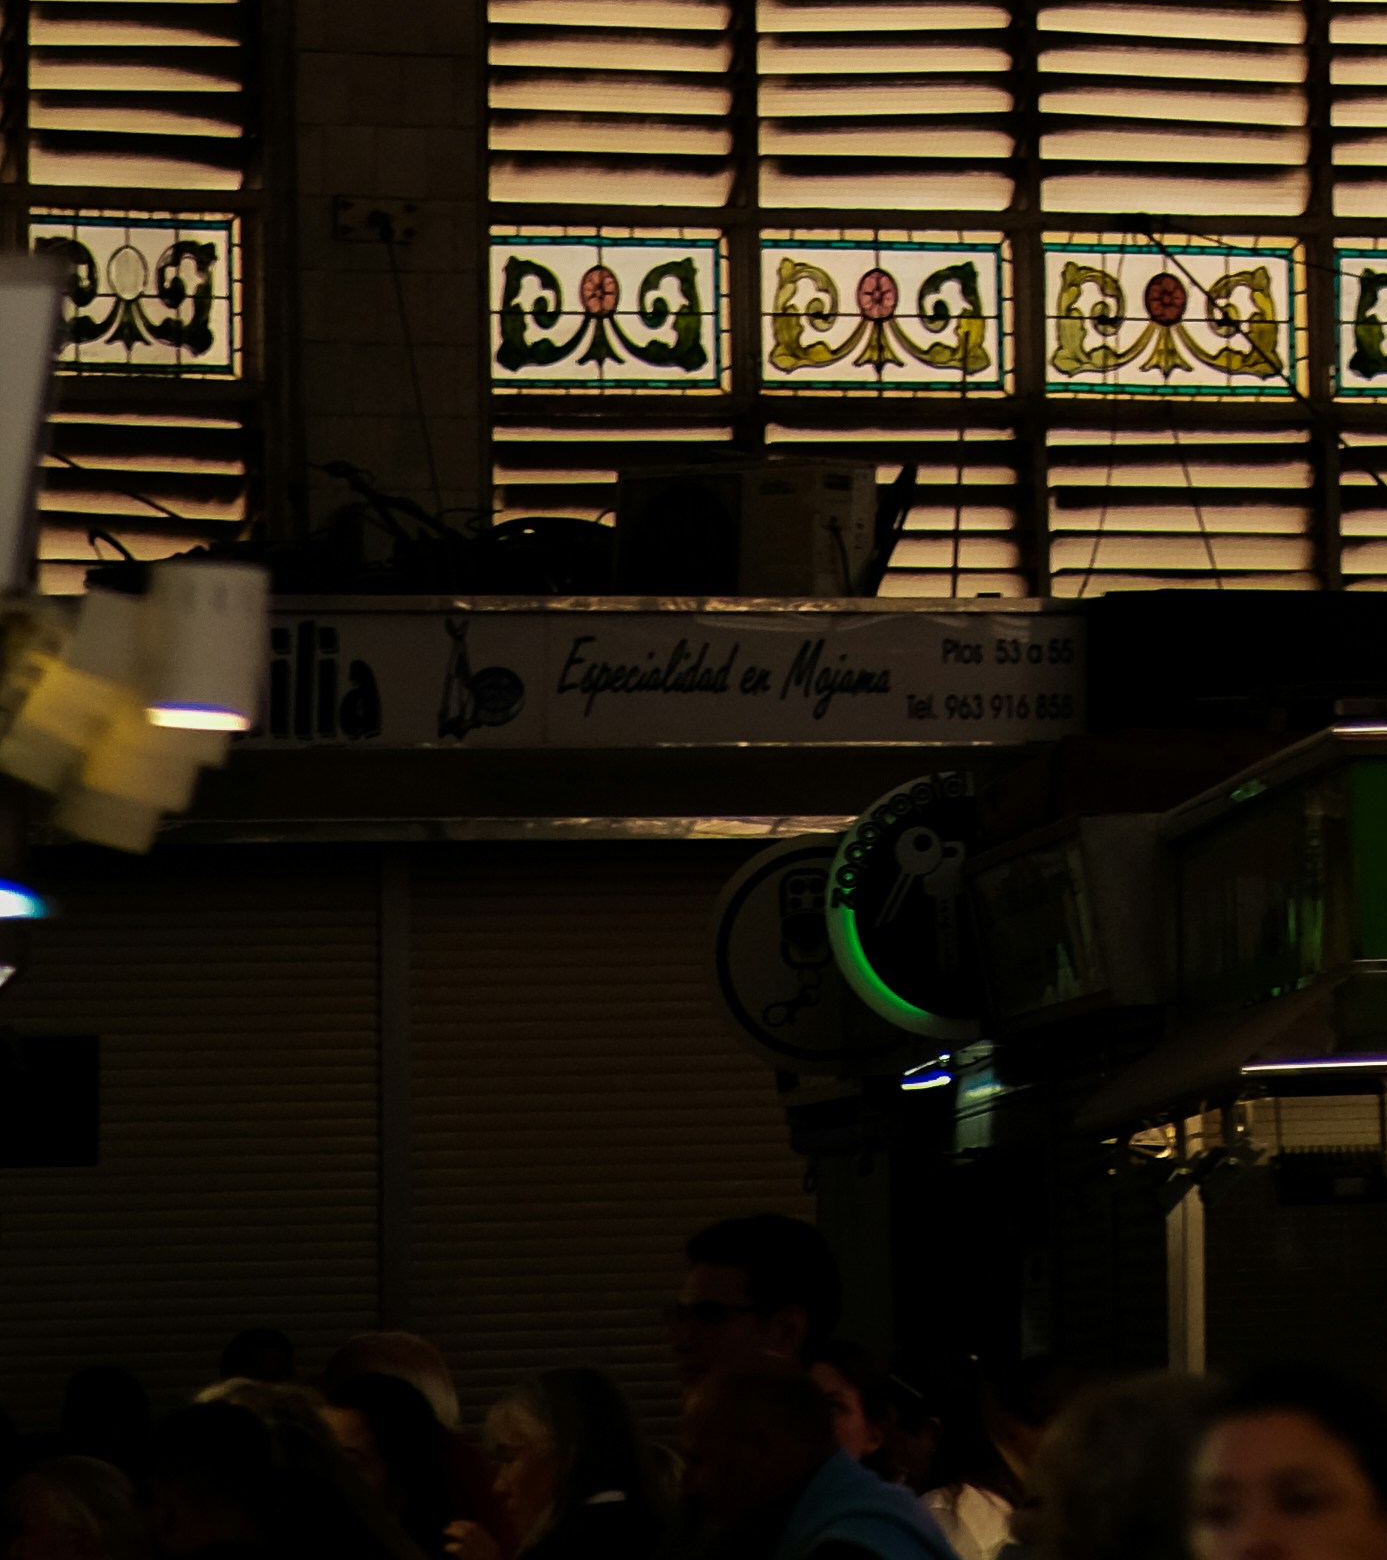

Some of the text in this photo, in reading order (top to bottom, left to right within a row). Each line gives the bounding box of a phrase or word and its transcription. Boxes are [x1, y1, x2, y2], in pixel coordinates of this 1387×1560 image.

[557, 636, 891, 720] Especialidad en Mojama
[995, 638, 1020, 664] 53
[1027, 643, 1043, 664] a
[1047, 638, 1074, 664] 55
[252, 621, 381, 740] ilia
[907, 694, 938, 720] Tel.
[944, 694, 985, 720] 963
[990, 694, 1030, 720] 916
